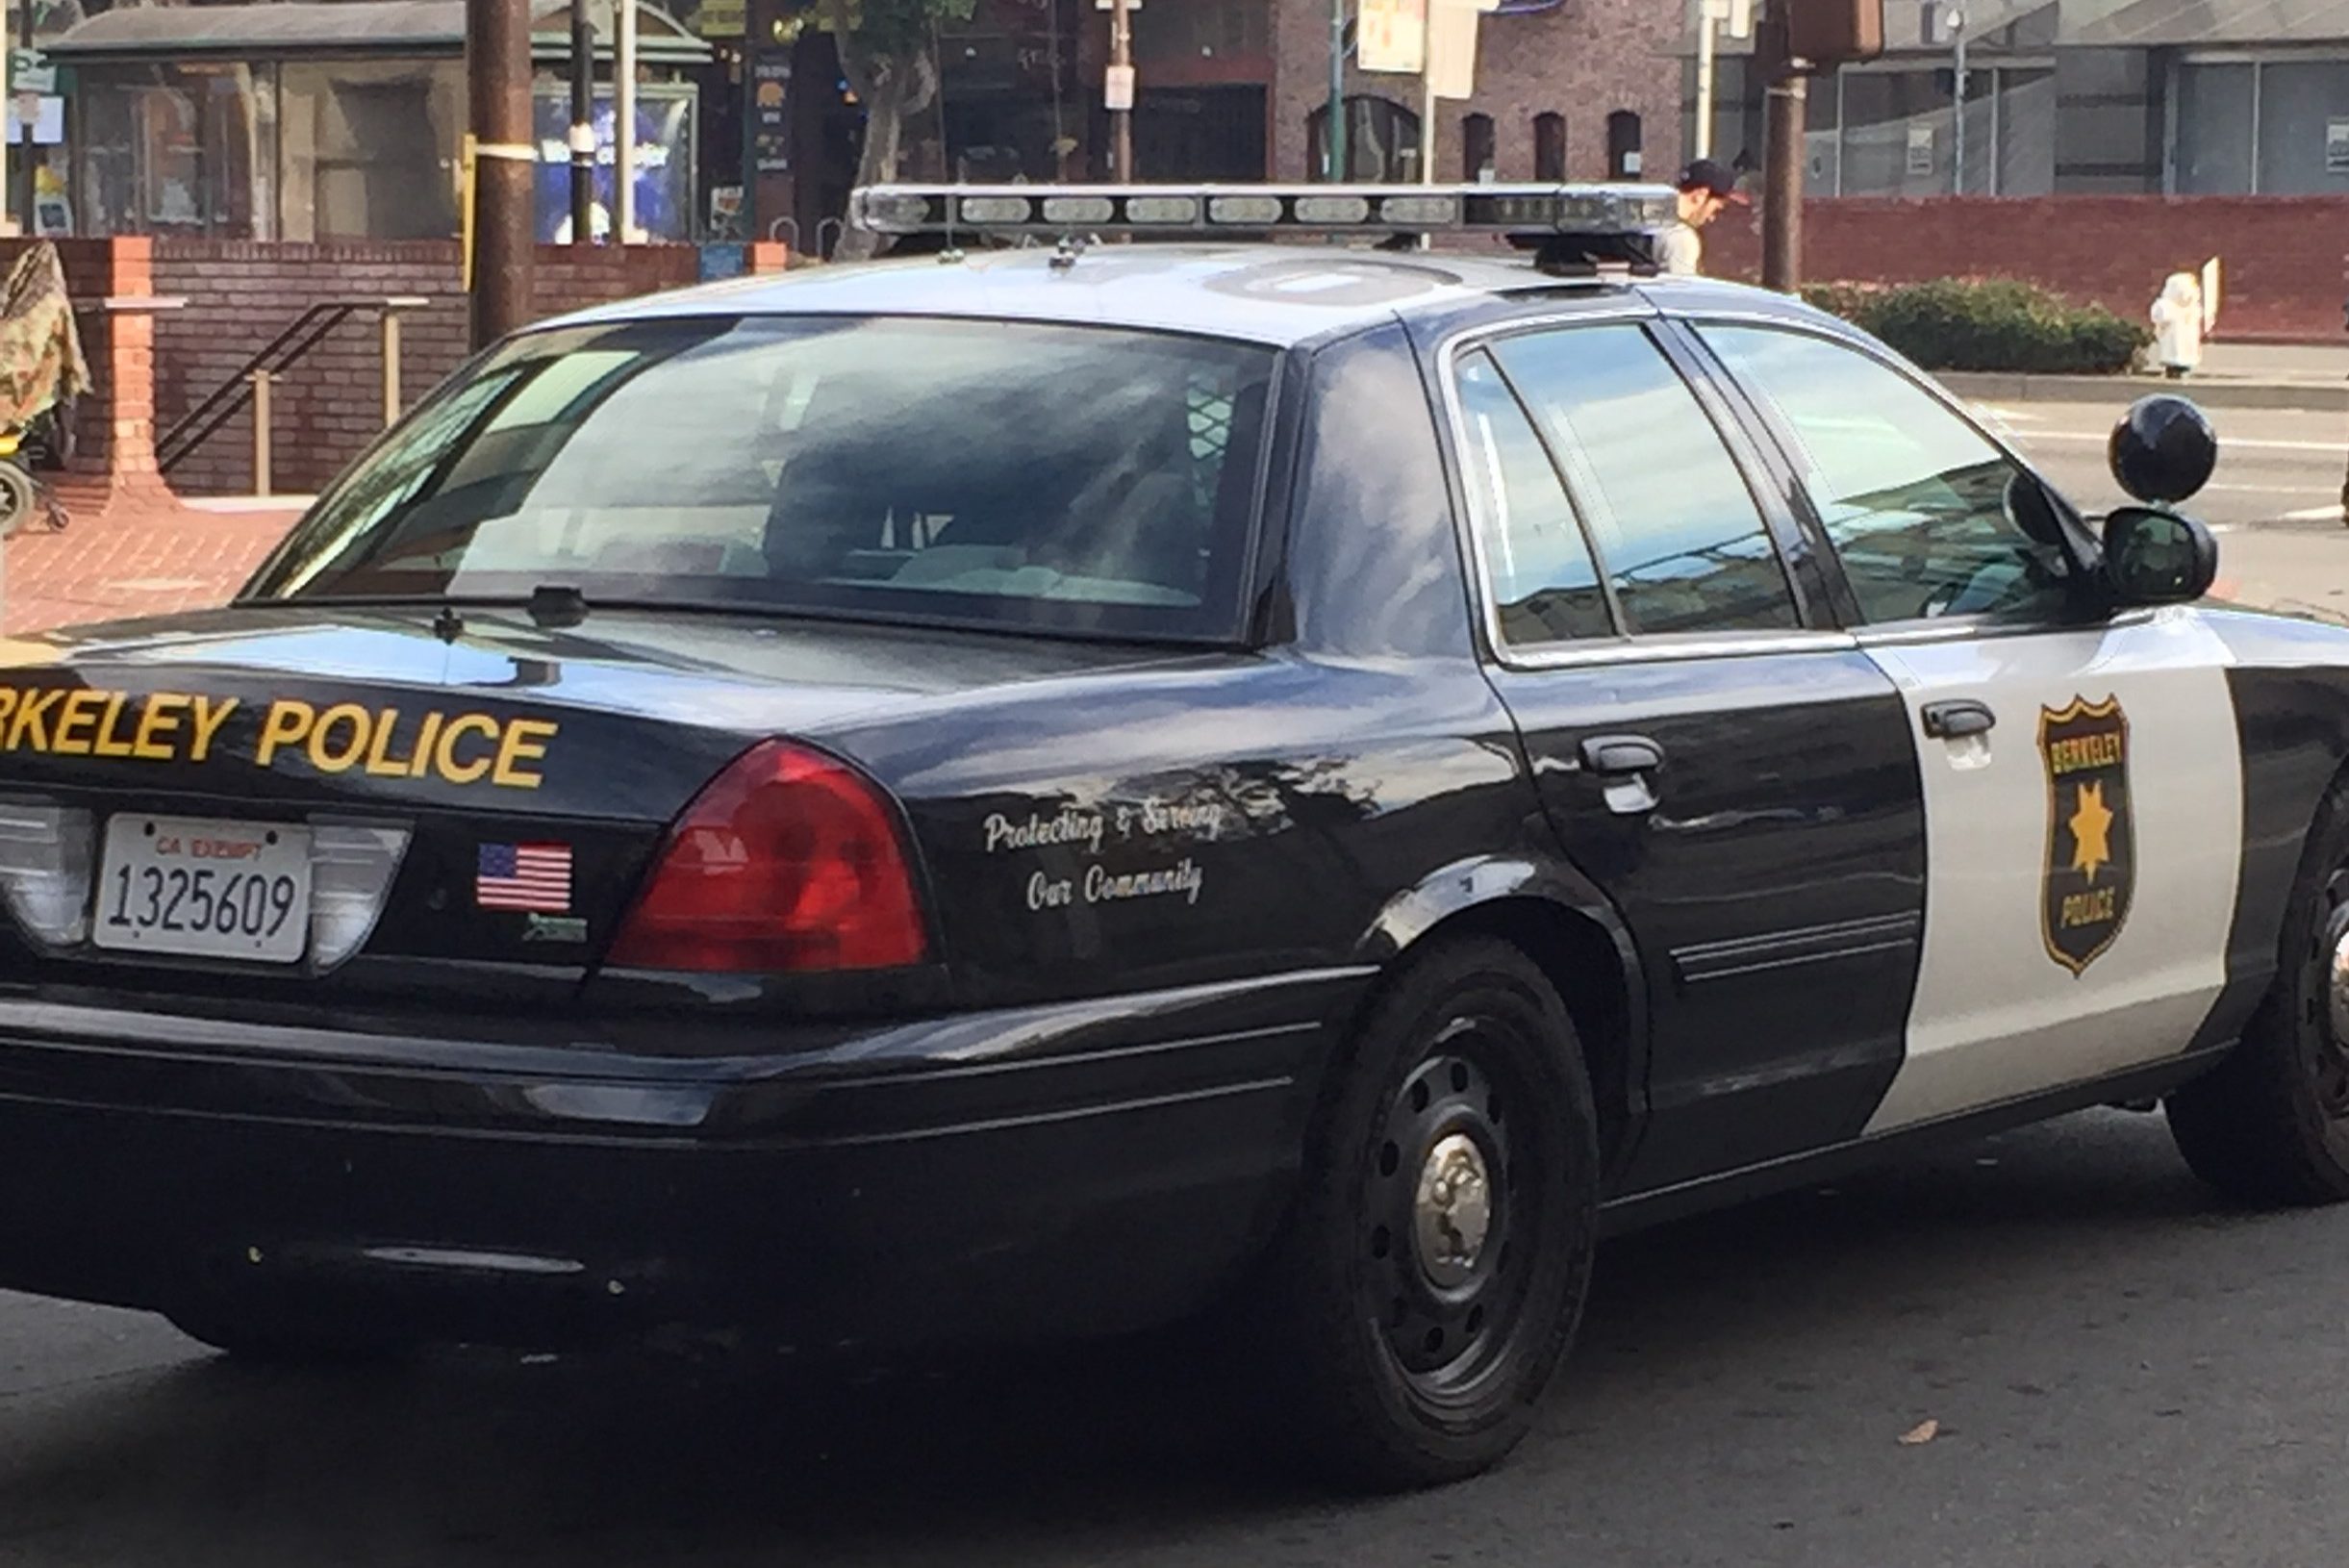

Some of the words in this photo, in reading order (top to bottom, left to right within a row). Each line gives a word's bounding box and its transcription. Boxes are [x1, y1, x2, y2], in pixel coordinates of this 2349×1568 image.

[256, 700, 558, 788] POLICE
[2052, 734, 2121, 773] BERKELEY
[156, 837, 181, 854] CA
[983, 814, 1102, 852] Protecting
[1116, 811, 1134, 836] &
[108, 864, 294, 937] 1325609
[1026, 872, 1072, 910] Our
[1085, 859, 1203, 904] Community
[2061, 887, 2114, 928] POLICE
